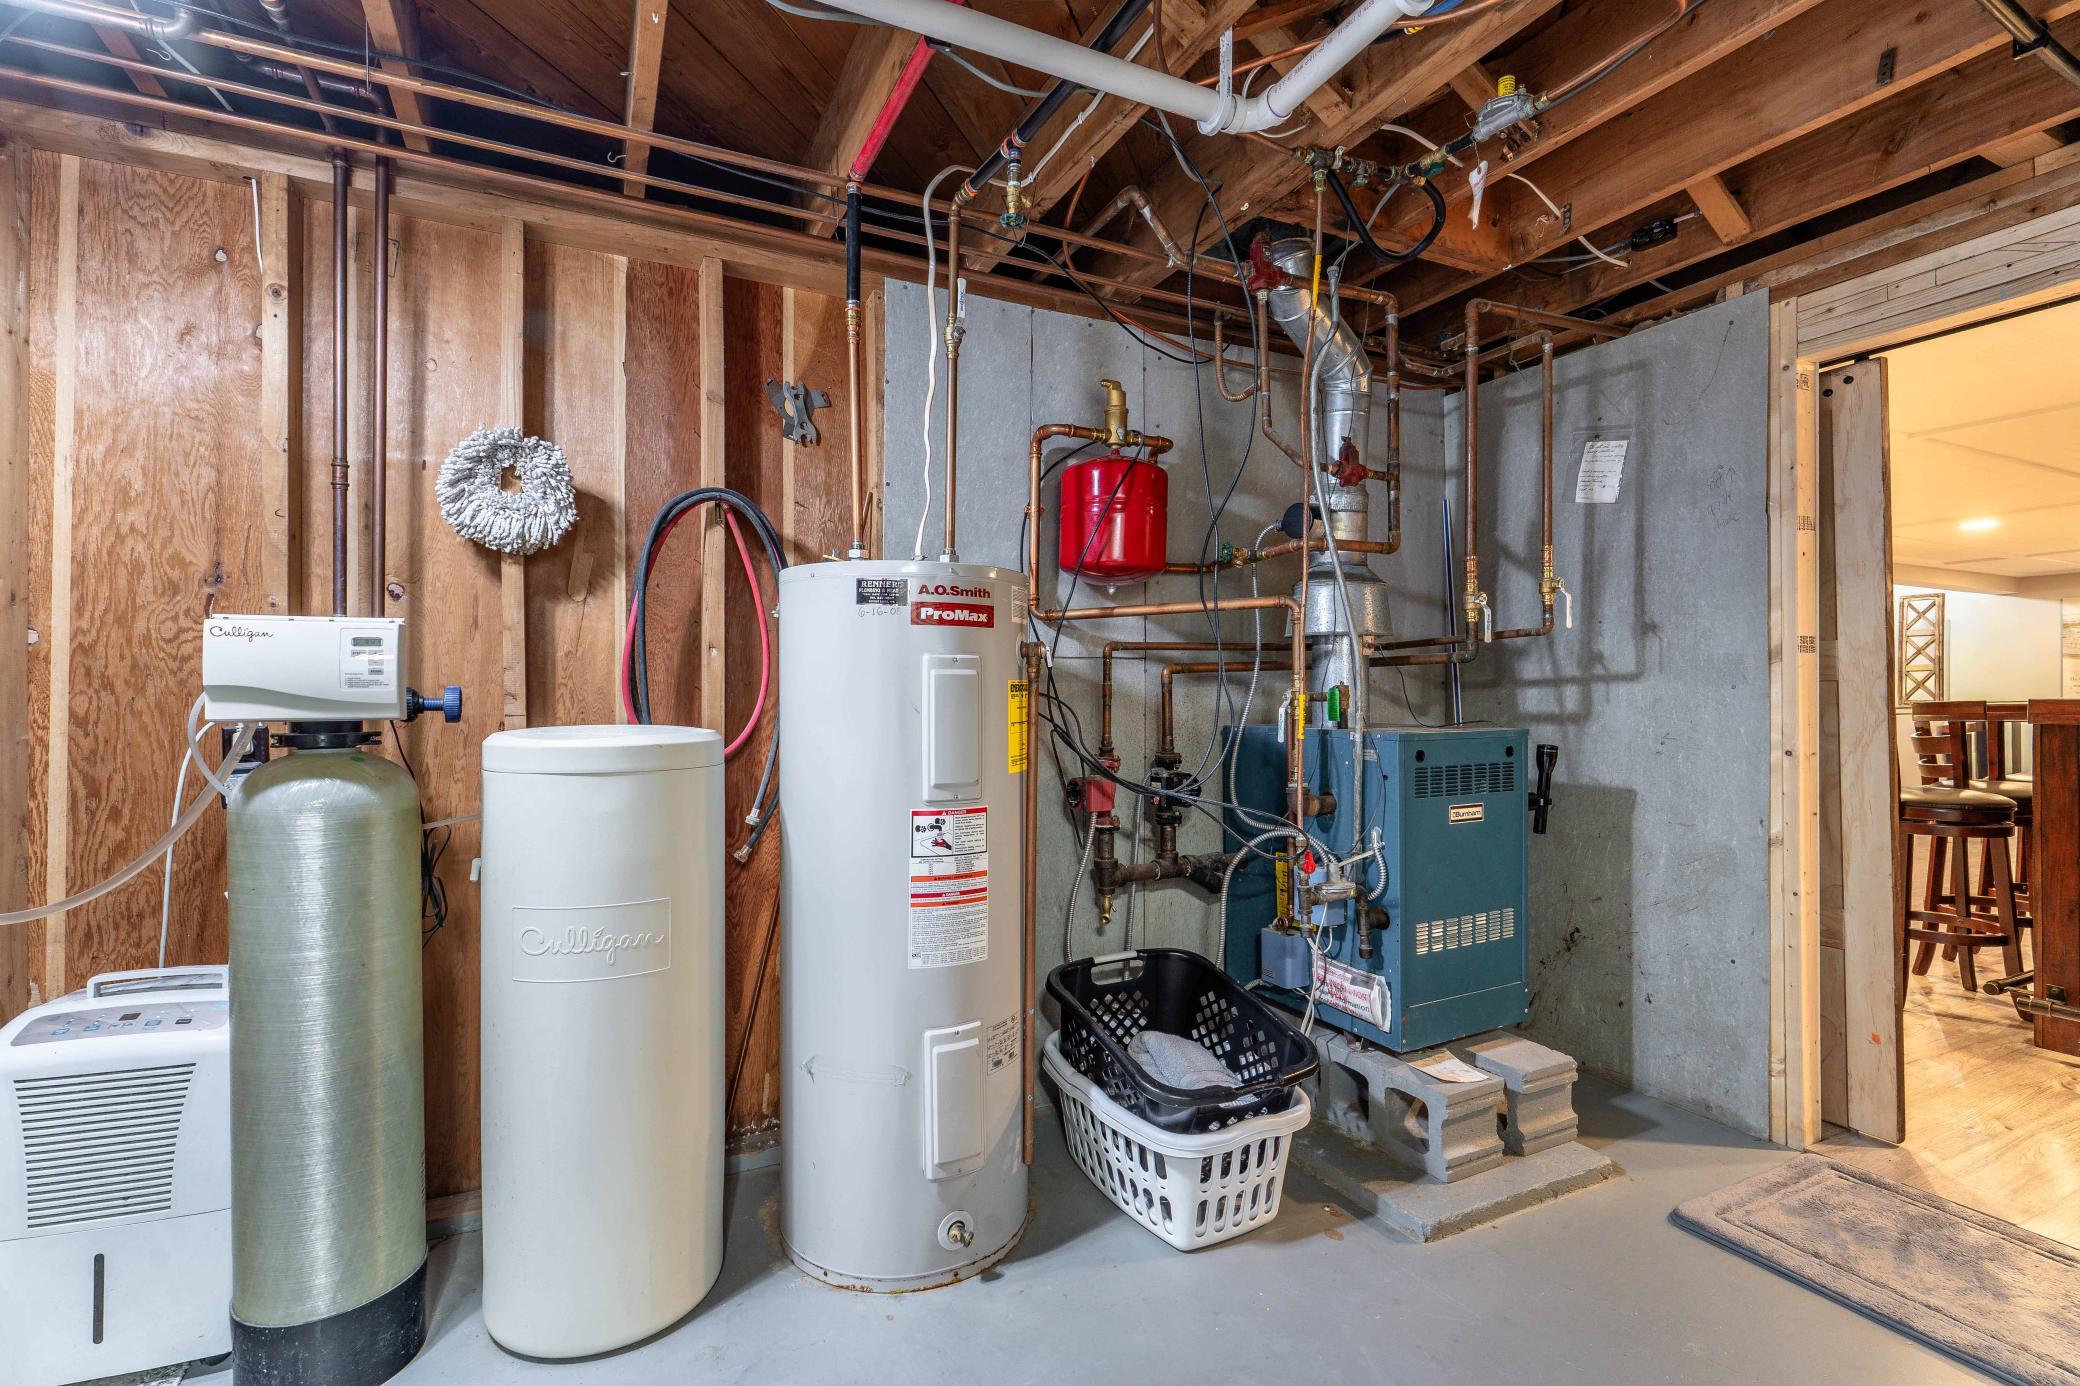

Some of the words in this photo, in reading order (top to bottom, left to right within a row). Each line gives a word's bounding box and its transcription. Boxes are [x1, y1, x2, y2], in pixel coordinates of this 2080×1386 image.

[920, 607, 989, 623] ProMax
[209, 625, 274, 643] Culligan
[1455, 810, 1481, 818] Burnham
[519, 925, 665, 966] Culligan
